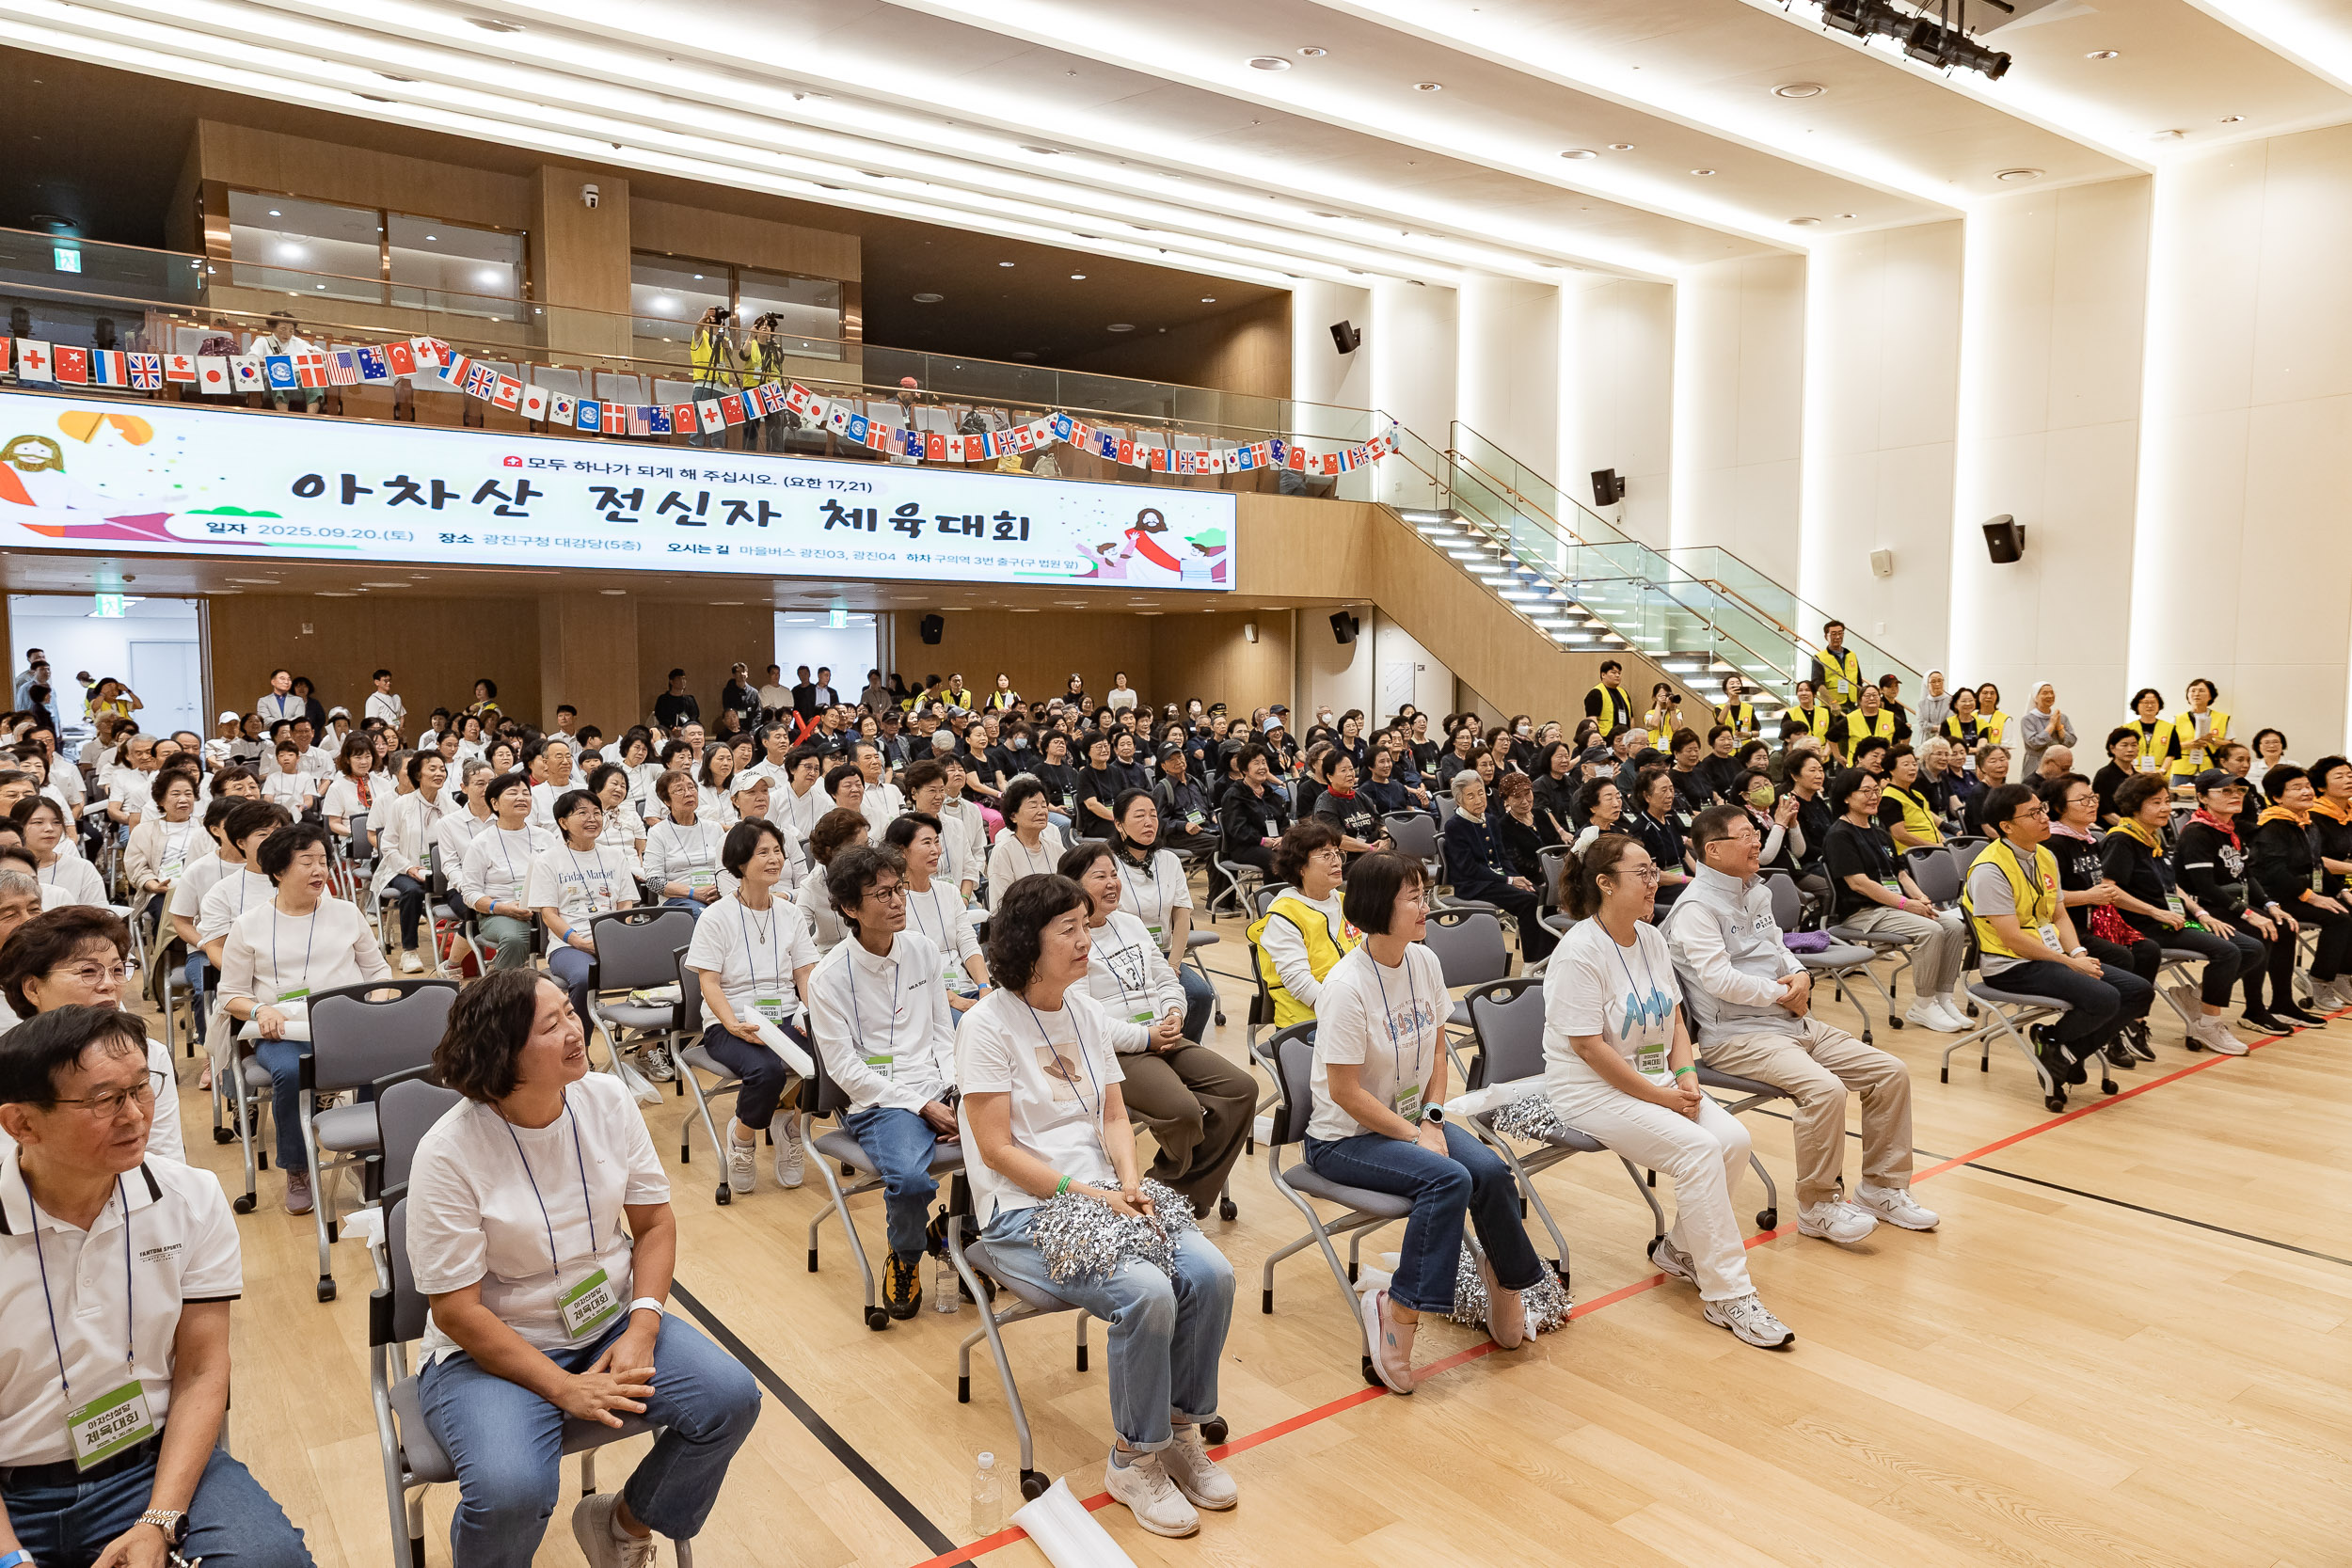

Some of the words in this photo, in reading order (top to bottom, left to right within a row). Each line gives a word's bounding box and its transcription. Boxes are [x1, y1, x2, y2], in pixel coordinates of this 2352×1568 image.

[528, 457, 567, 470] 모두
[574, 461, 631, 475] 하나가
[637, 466, 674, 479] 되게
[680, 468, 697, 481] 해
[703, 470, 777, 485] 주십시오.
[784, 476, 821, 489] (요한
[828, 480, 872, 494] 17,21)
[291, 472, 544, 517] 아차산
[588, 485, 783, 528] 전신자
[819, 499, 1029, 542] 체육대회
[206, 522, 248, 534] 일자
[258, 524, 414, 542] 2025.09.20.(토)
[438, 532, 474, 544] 장소
[483, 533, 549, 547] 광진구청
[555, 536, 642, 552] 대강당(5층)
[667, 543, 712, 554] 오시는
[716, 545, 730, 555] 길
[739, 545, 796, 557] 마을버스
[800, 547, 849, 562] 광진03,
[853, 549, 897, 562] 광진04
[906, 553, 930, 563] 하차
[934, 554, 971, 565] 구의역
[974, 556, 994, 566] 3번
[1039, 559, 1061, 569] 법원
